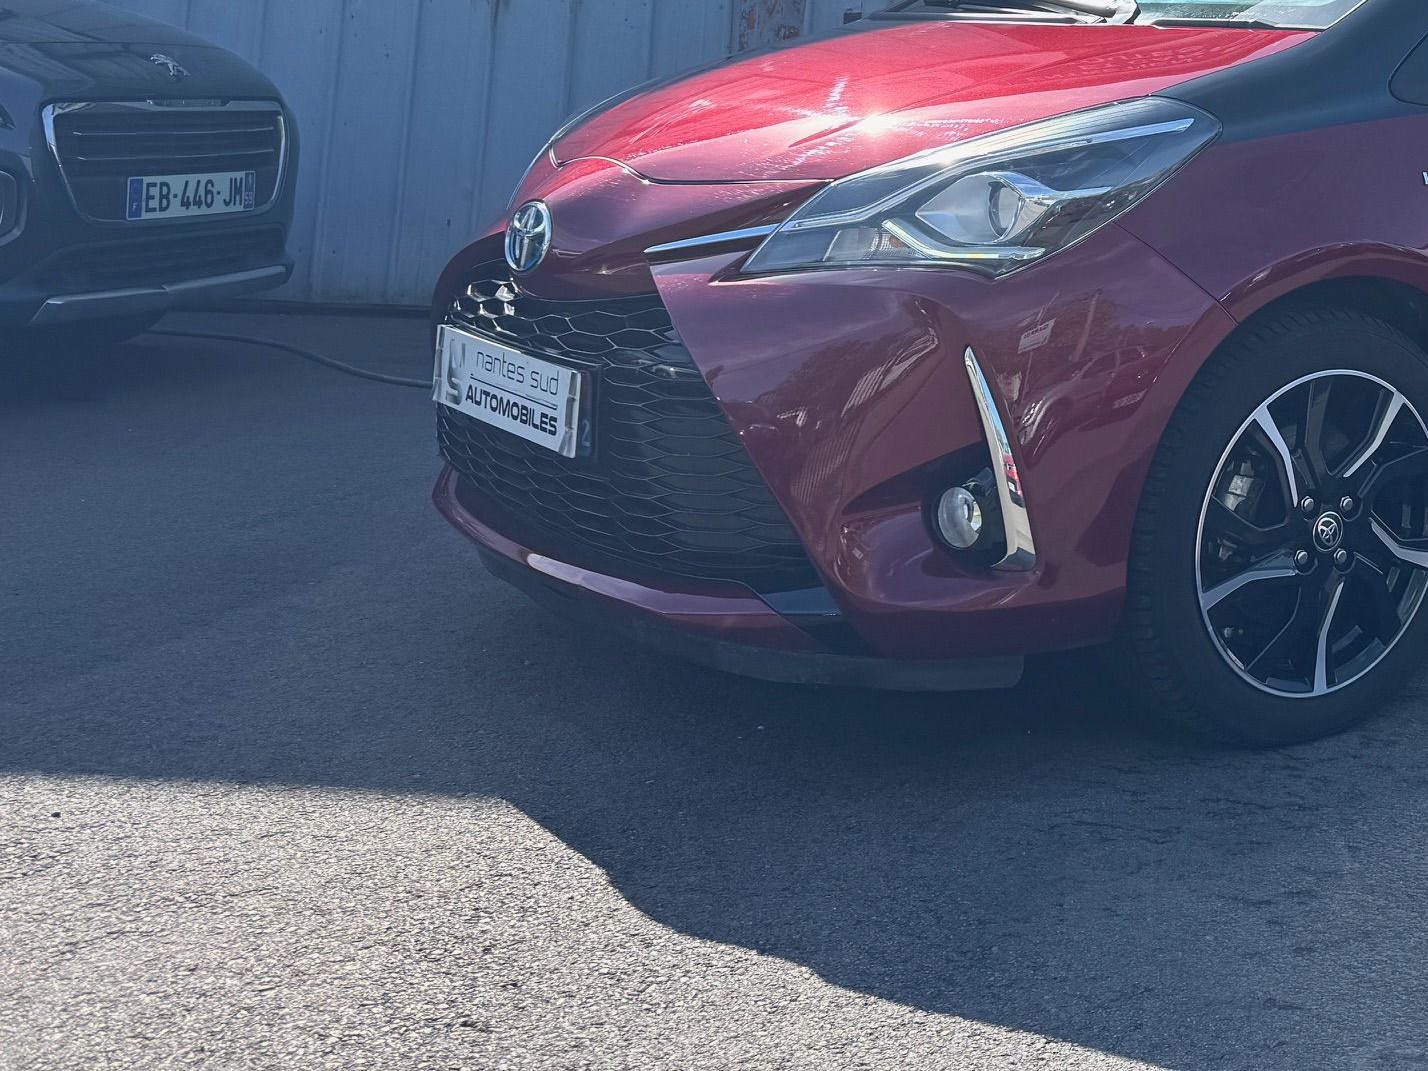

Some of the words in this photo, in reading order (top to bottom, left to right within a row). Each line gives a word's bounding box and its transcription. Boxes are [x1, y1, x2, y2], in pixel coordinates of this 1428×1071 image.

[144, 176, 244, 213] EB-446-JM
[475, 350, 525, 384] nantes
[530, 370, 560, 396] sud
[465, 384, 559, 437] AUTOMOBILES
